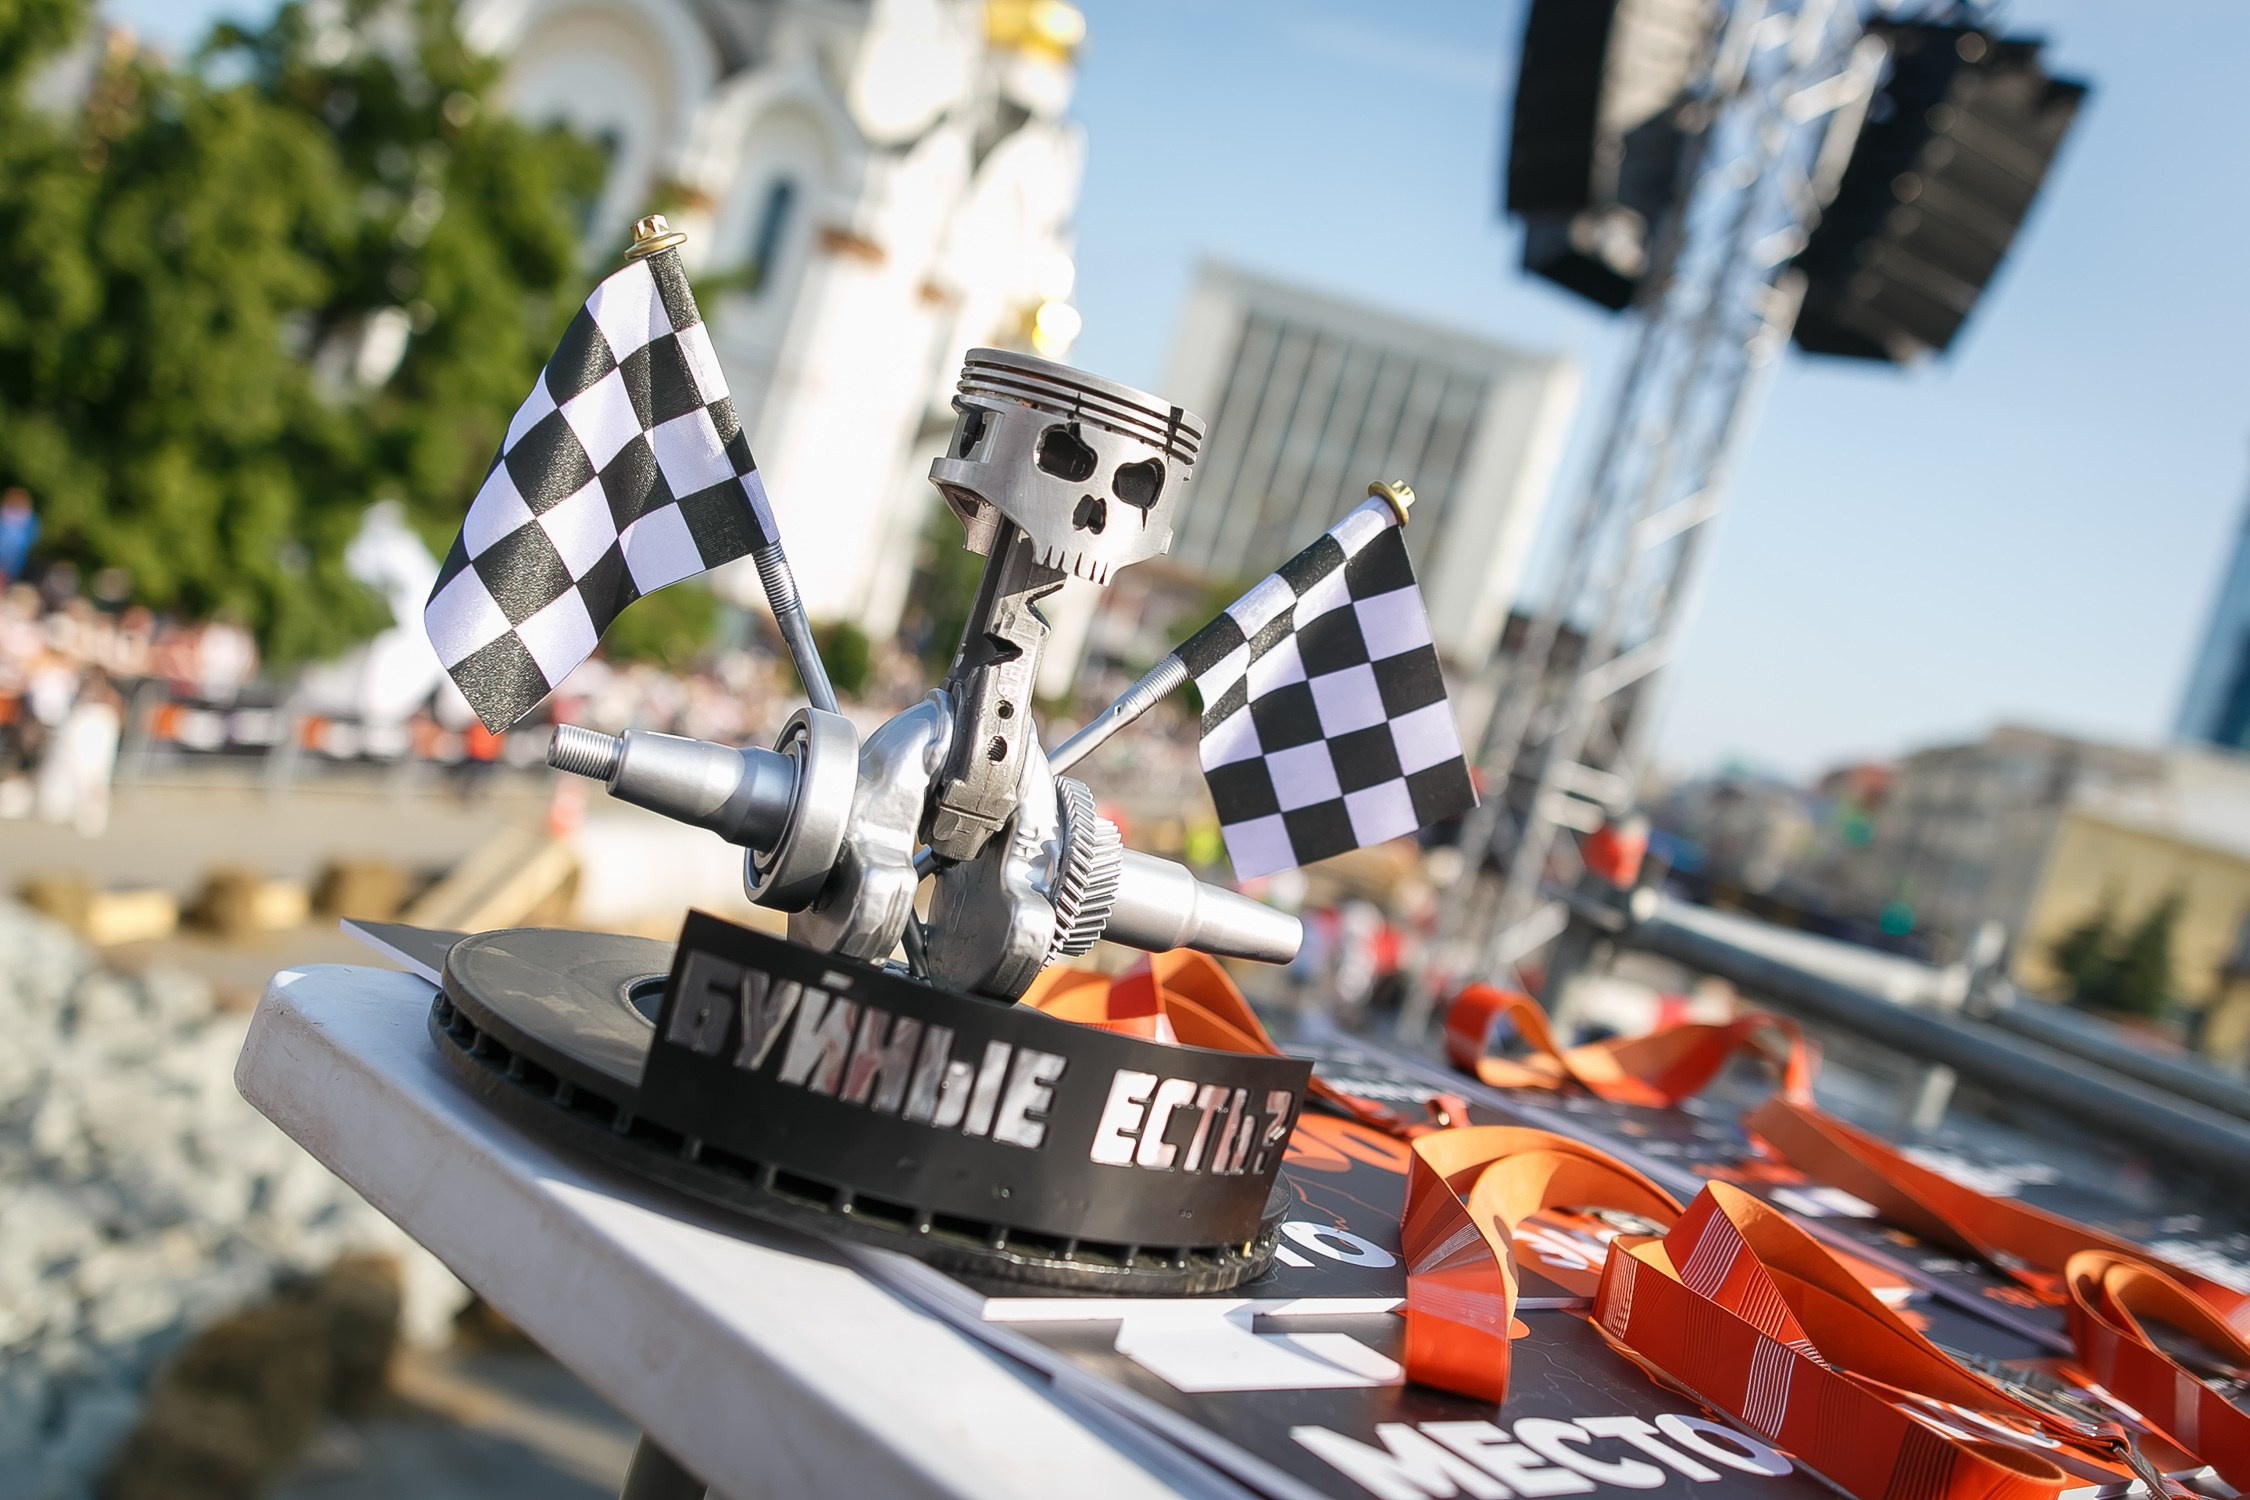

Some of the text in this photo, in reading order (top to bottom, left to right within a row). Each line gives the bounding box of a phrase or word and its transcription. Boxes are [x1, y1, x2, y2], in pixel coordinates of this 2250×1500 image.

[665, 949, 1292, 1175] БУЙНЫЕ ЕСТЬ?
[1289, 1413, 1794, 1500] МЕСТО
